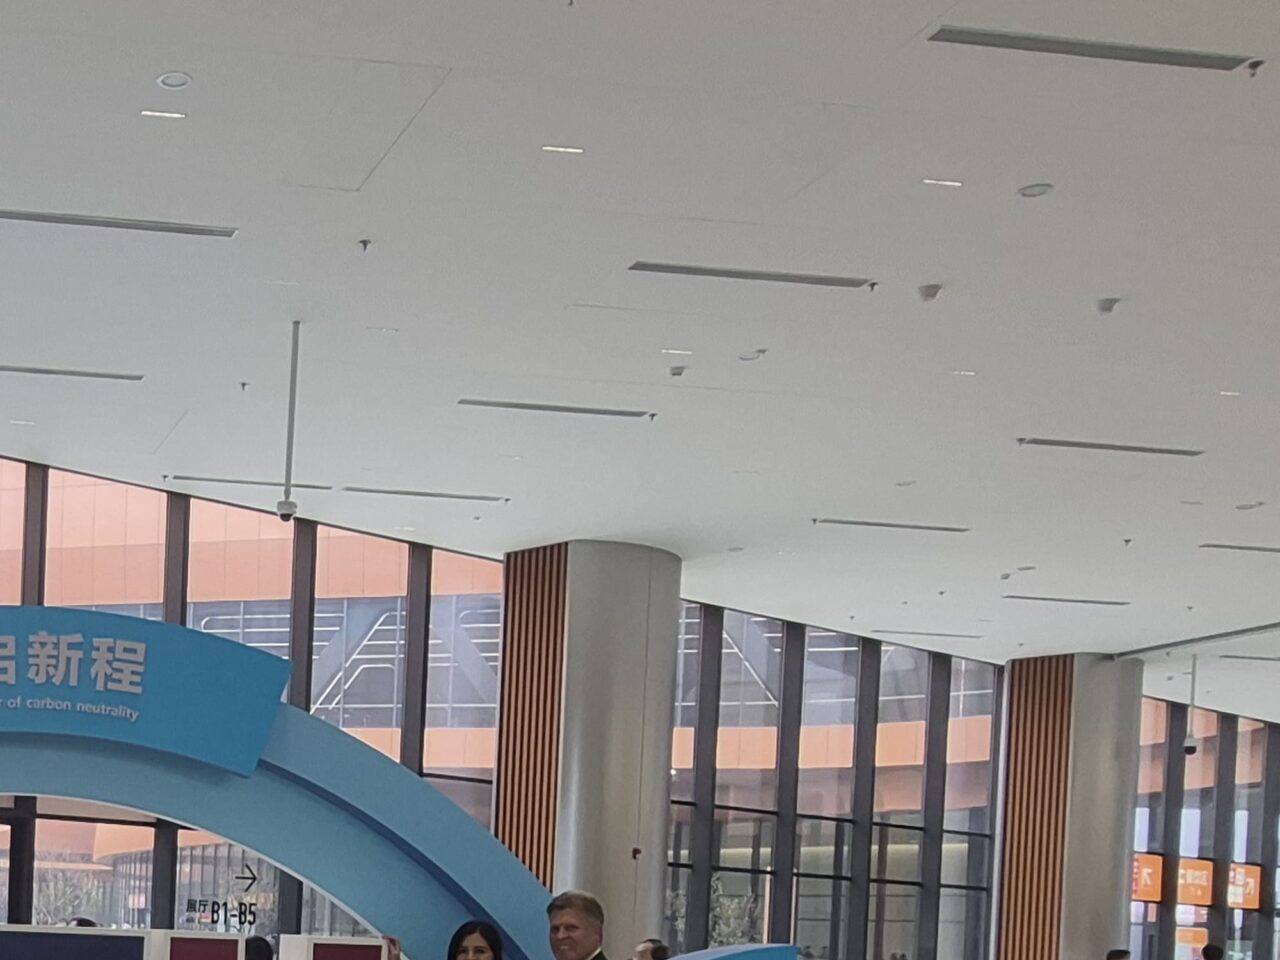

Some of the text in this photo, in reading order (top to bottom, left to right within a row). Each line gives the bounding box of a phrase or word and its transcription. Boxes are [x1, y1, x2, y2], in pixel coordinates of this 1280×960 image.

[7, 695, 20, 708] of
[26, 697, 71, 711] carbon
[76, 702, 140, 722] neutrality
[211, 901, 257, 926] B1-B5
